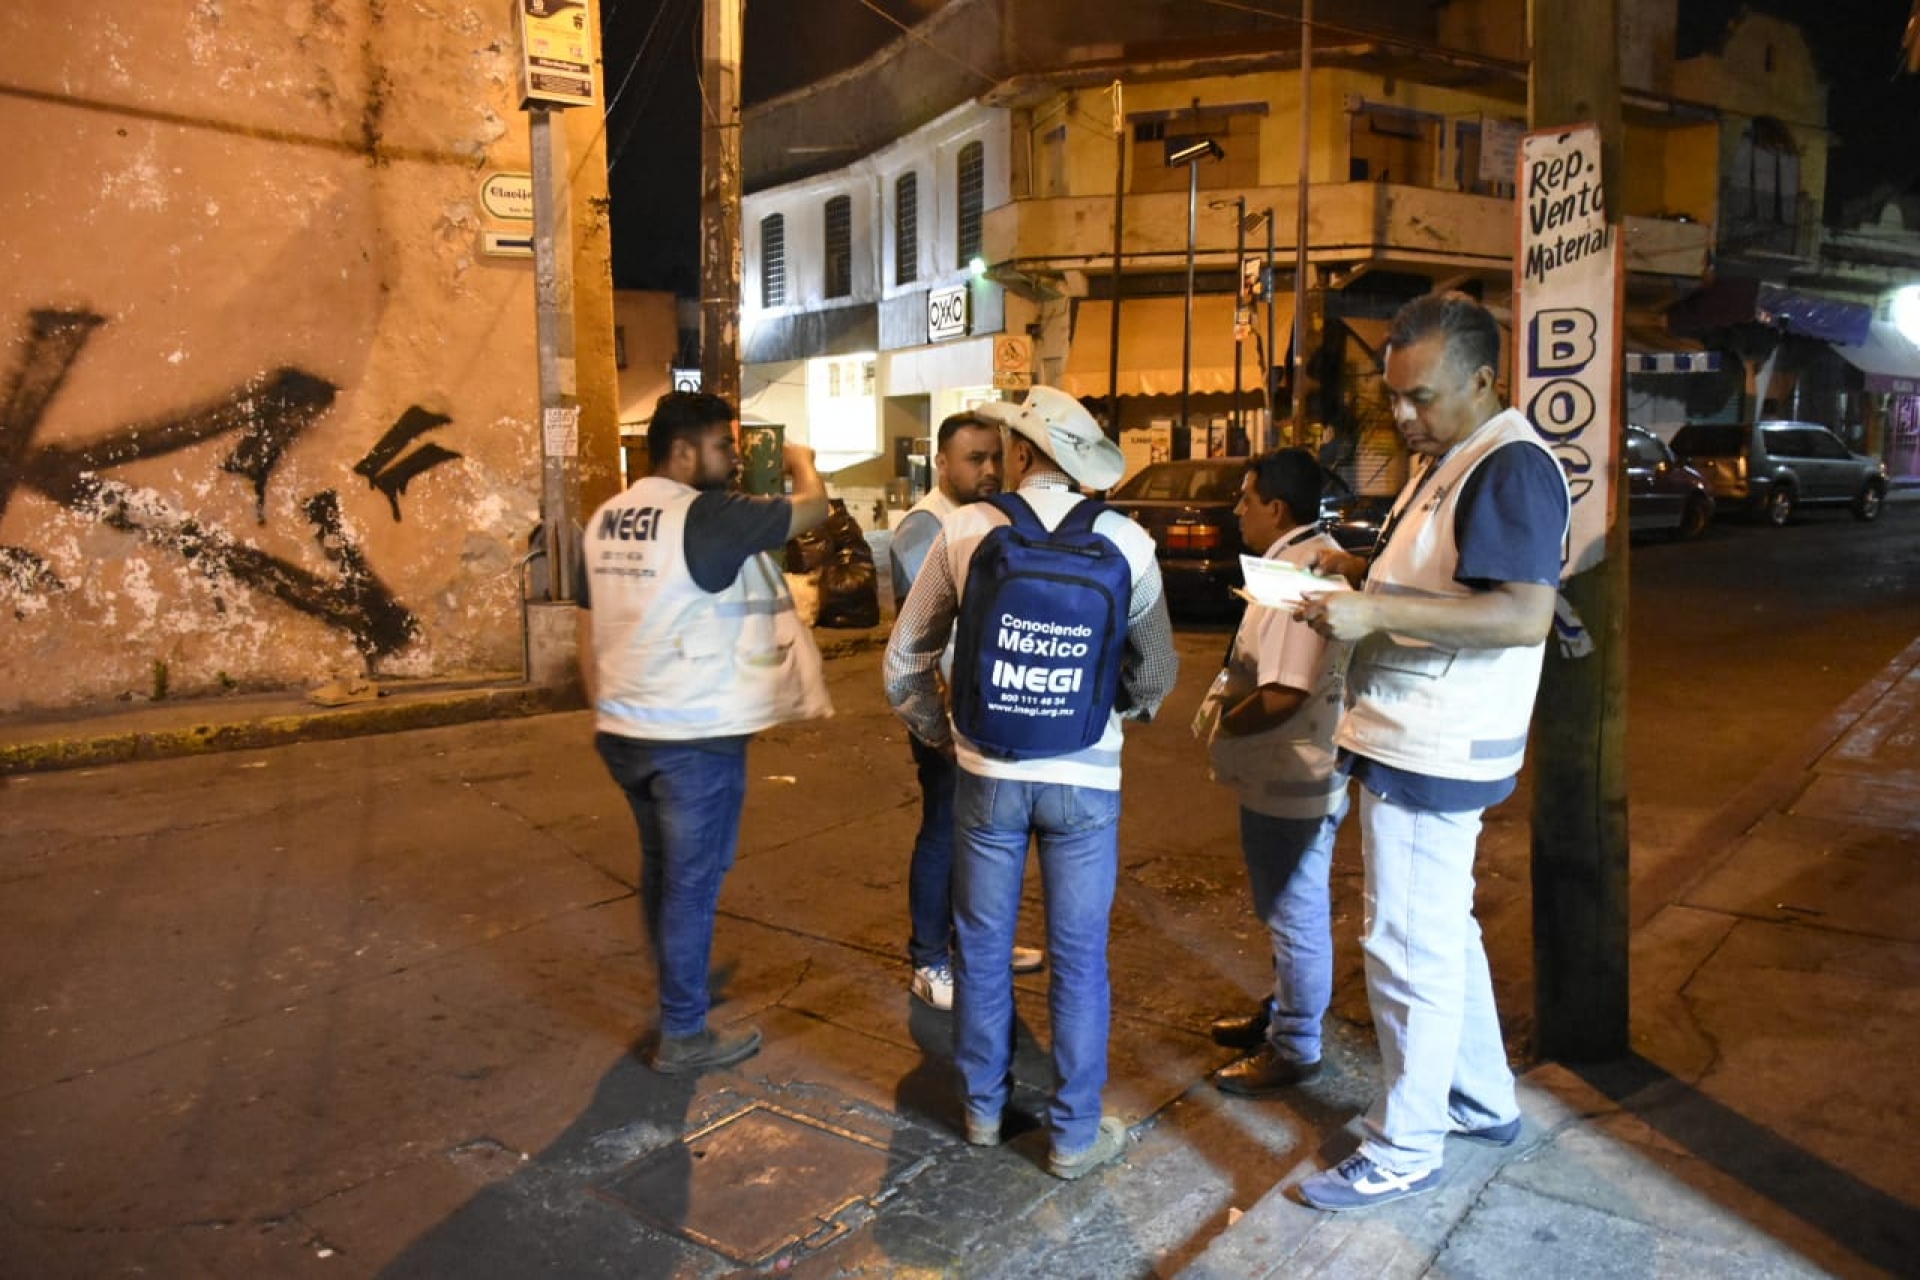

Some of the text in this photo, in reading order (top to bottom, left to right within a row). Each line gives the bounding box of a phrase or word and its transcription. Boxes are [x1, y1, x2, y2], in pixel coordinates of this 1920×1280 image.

[1529, 150, 1595, 198] Rep.
[1525, 225, 1609, 284] Material
[930, 296, 963, 327] OXXO
[1002, 614, 1092, 637] Conociendo
[998, 628, 1088, 657] México
[992, 660, 1083, 692] INEGI
